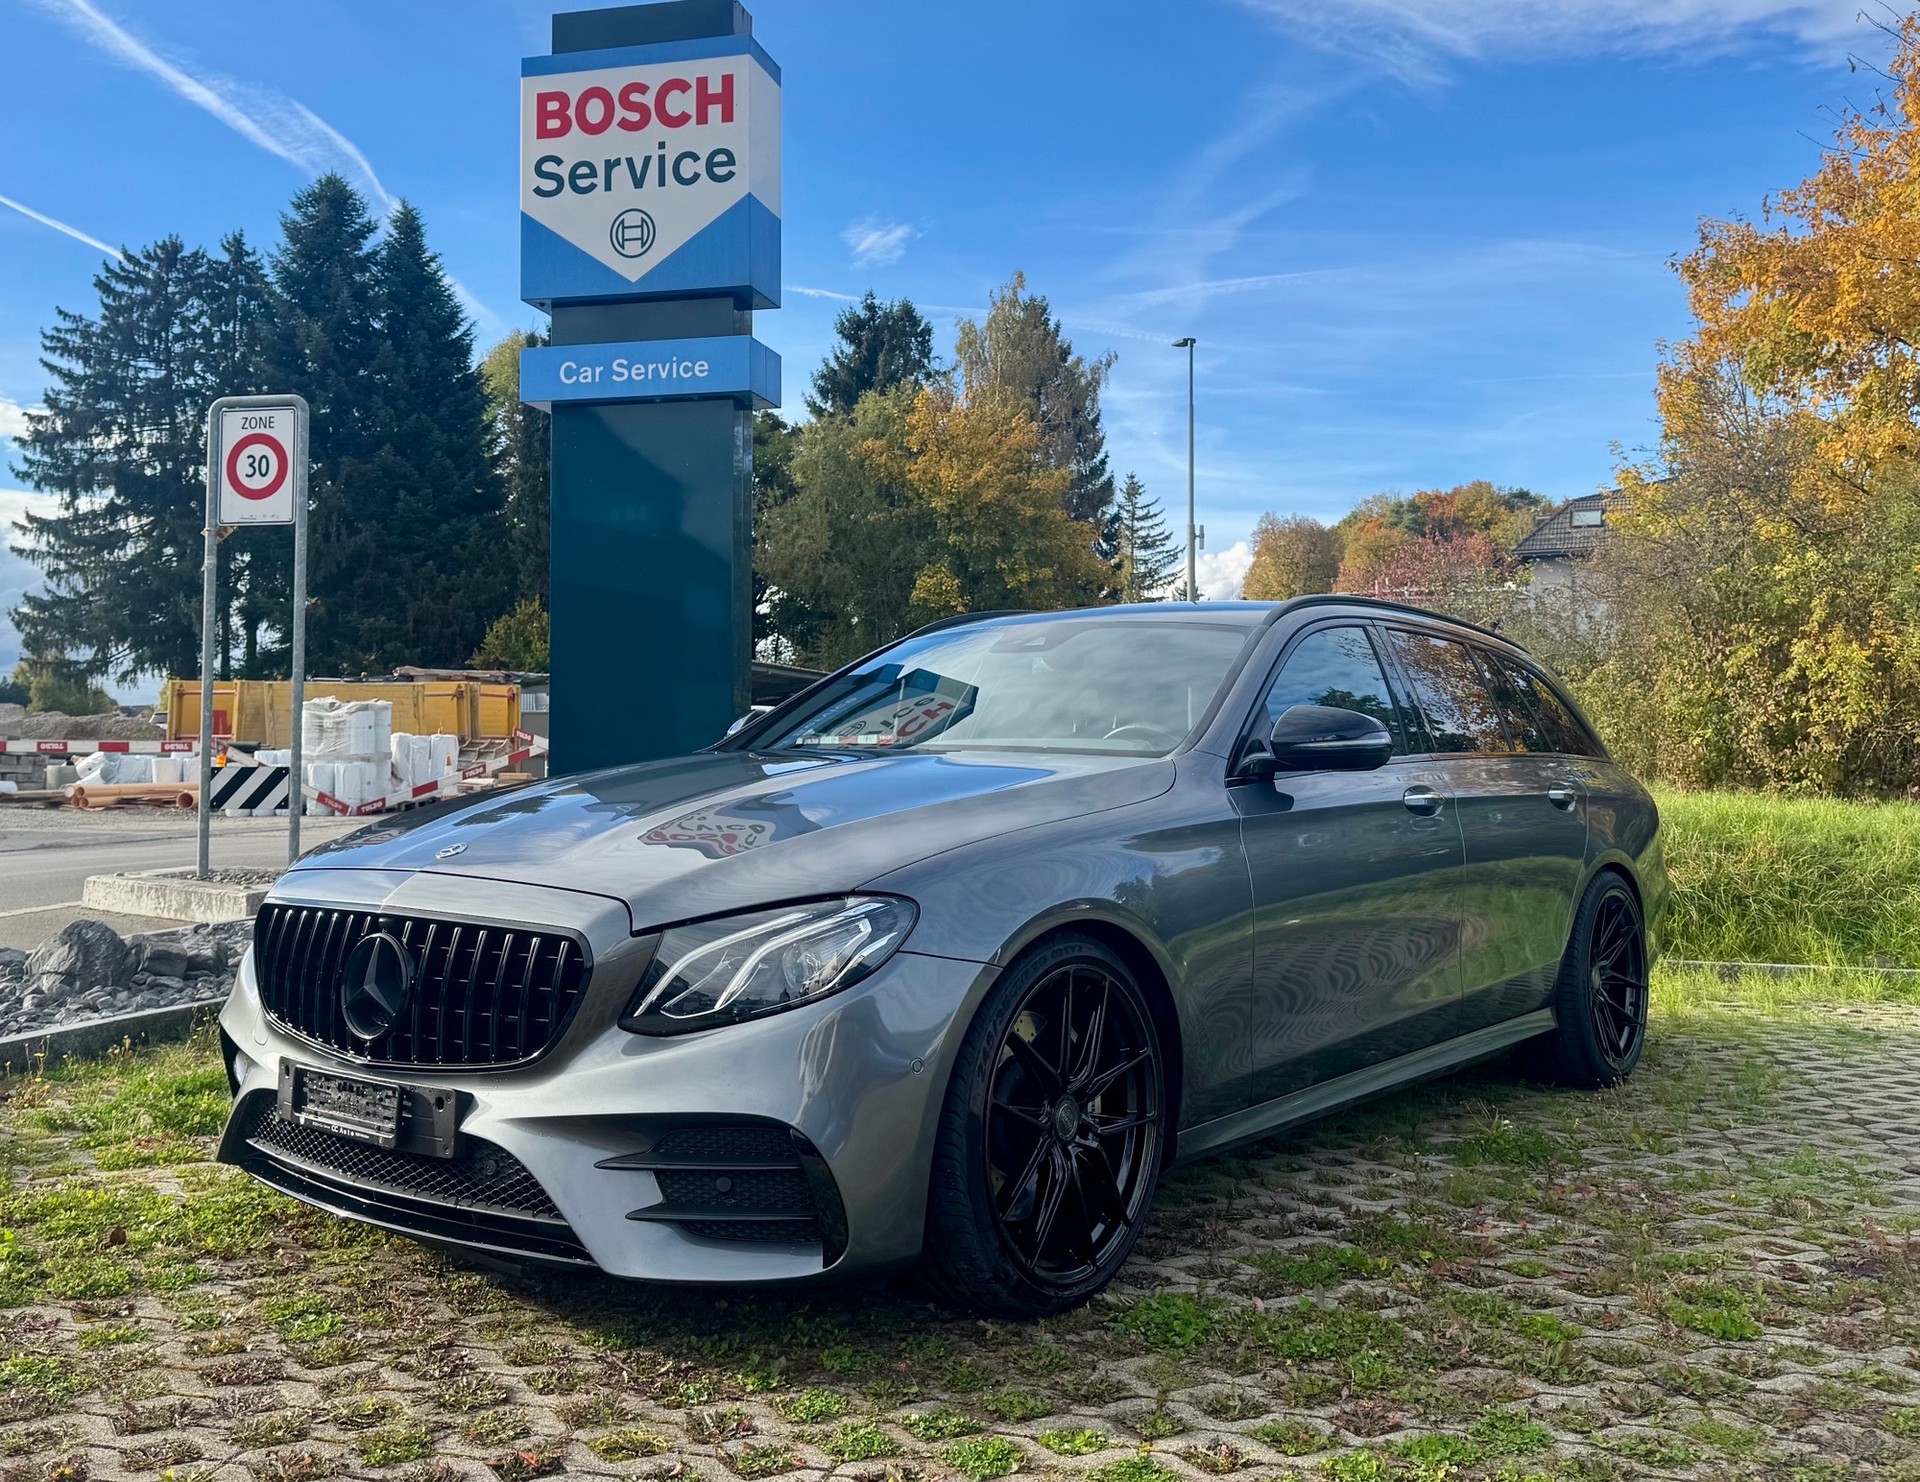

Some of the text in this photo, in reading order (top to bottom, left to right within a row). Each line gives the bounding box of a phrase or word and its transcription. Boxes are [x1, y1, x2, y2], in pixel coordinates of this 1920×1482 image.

[536, 73, 734, 140] BOSCH
[532, 141, 737, 198] Service
[559, 356, 709, 384] Car Service
[241, 416, 275, 430] ZONE
[245, 454, 270, 478] 30
[40, 742, 65, 750] TOLDO
